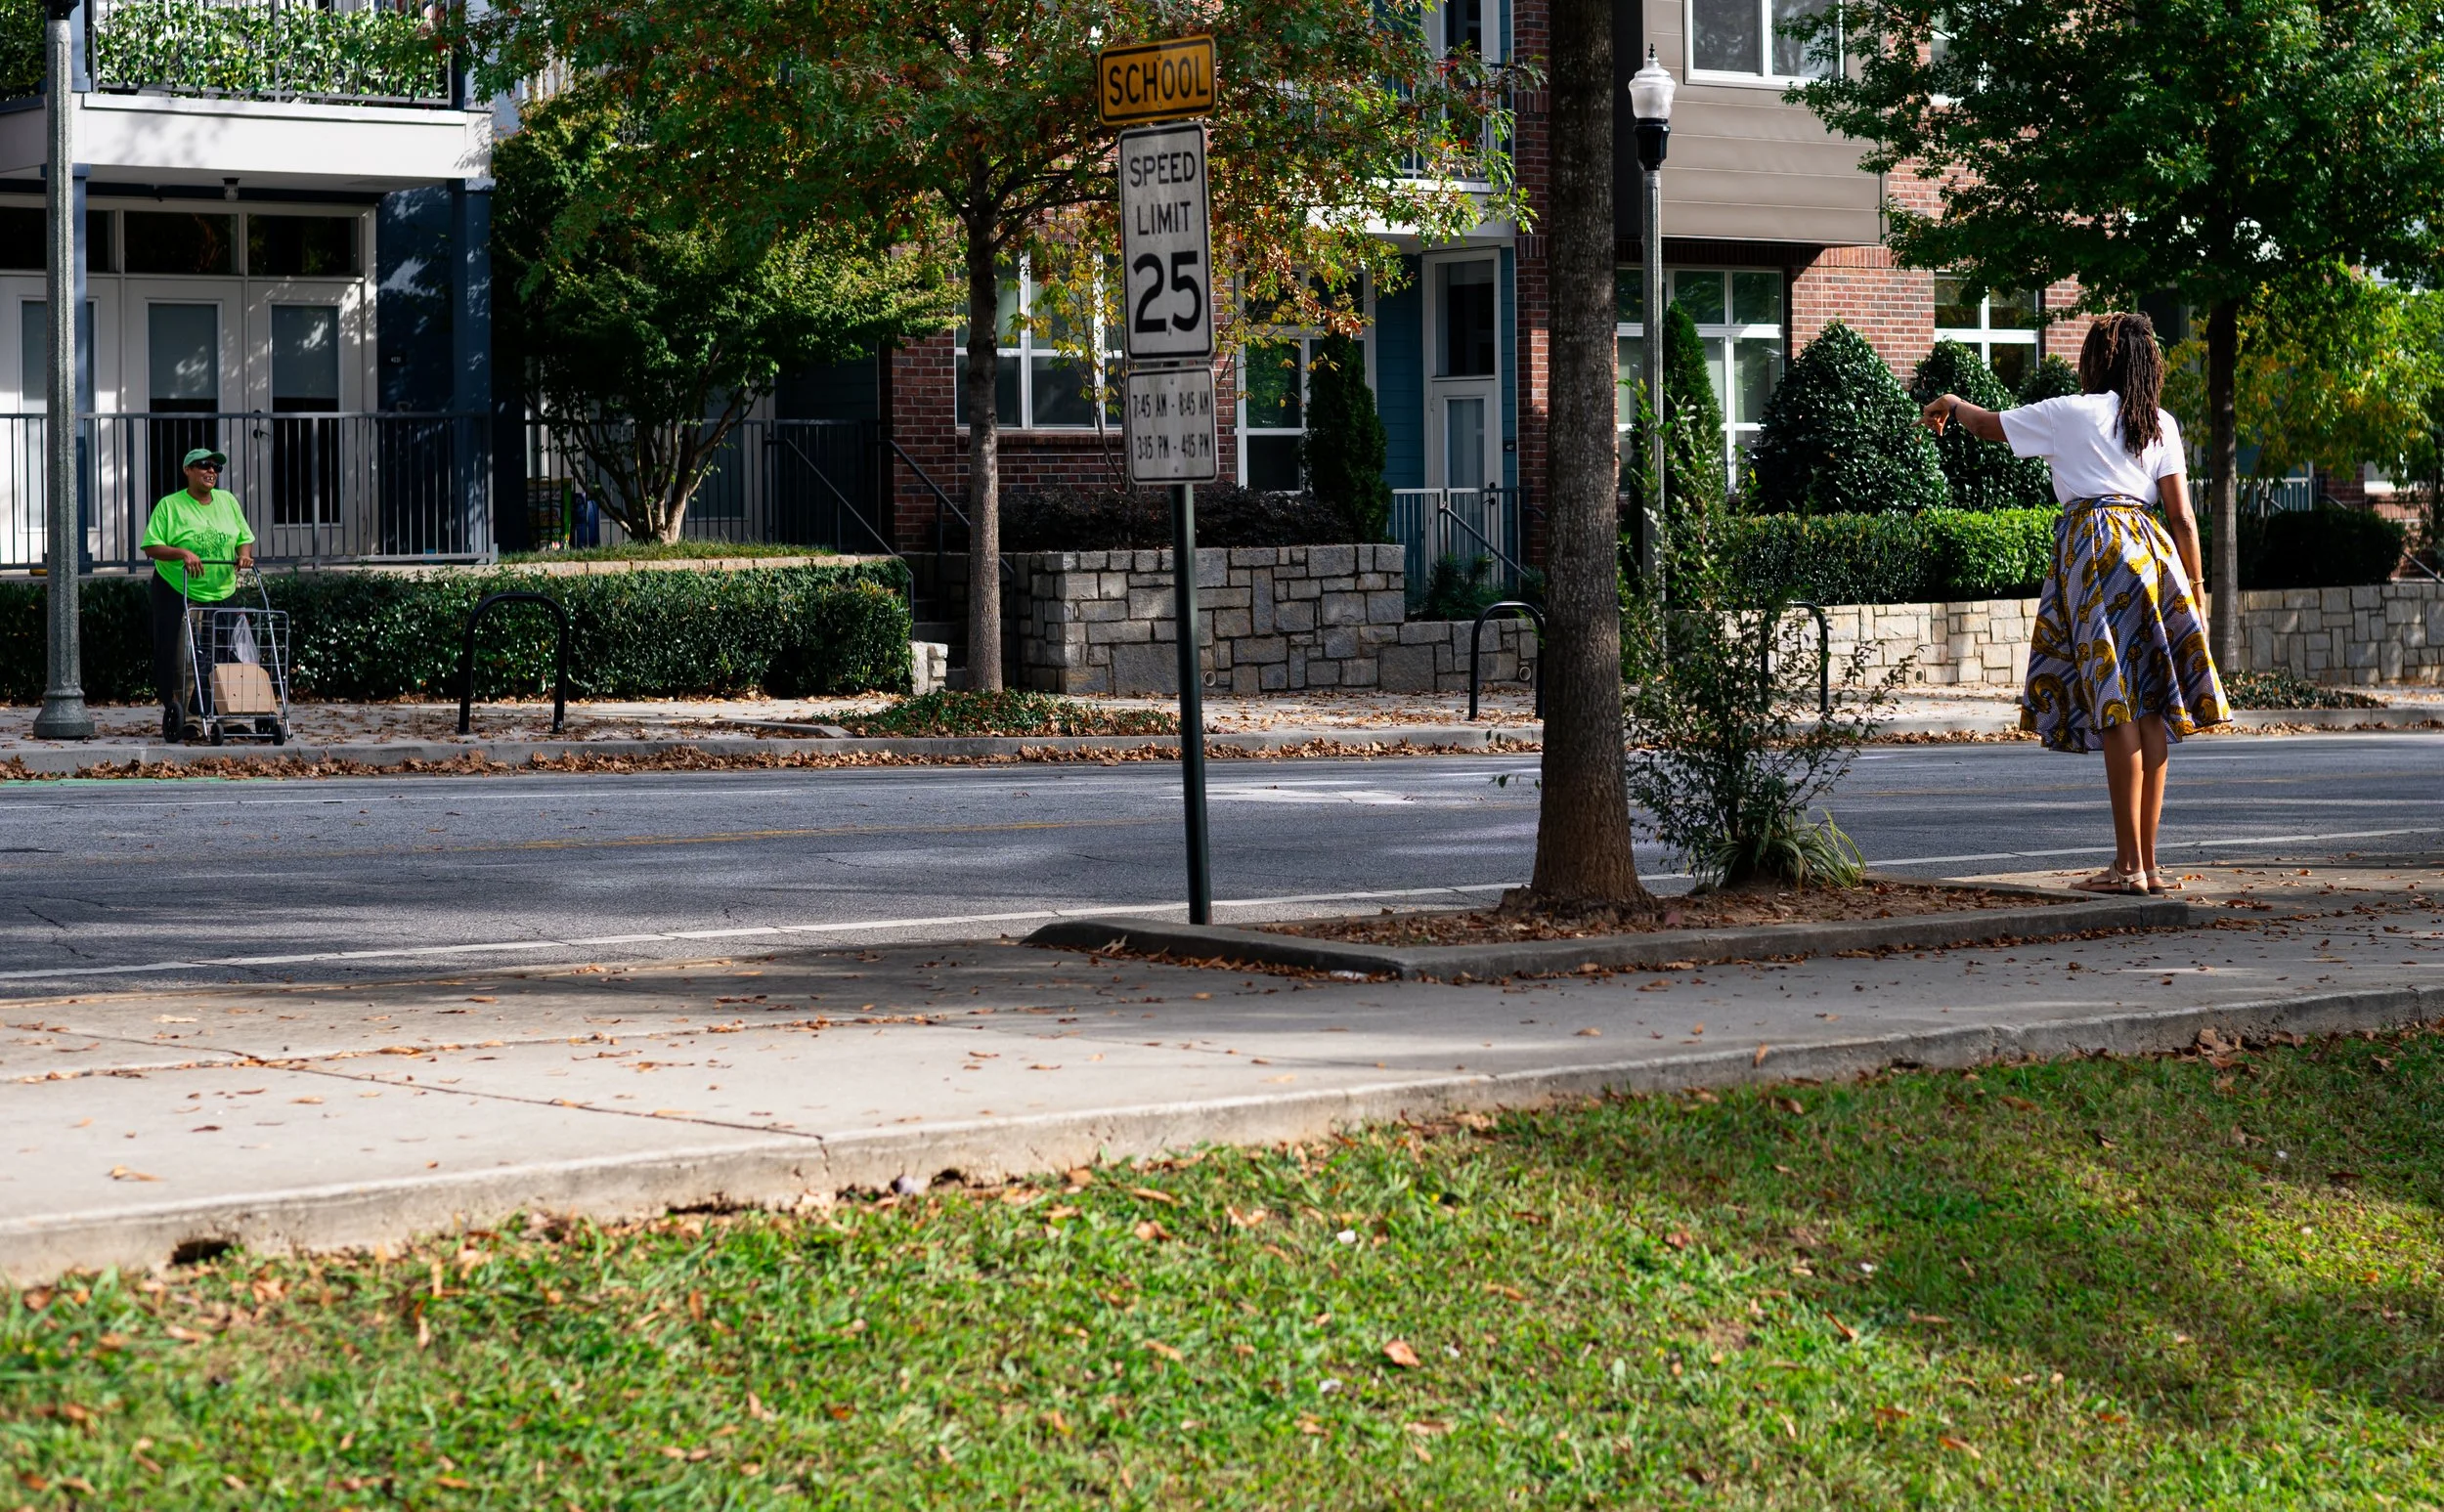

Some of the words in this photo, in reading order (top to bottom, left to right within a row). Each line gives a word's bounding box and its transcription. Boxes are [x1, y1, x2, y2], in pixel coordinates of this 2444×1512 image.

[1109, 56, 1208, 107] SCHOOL
[1130, 151, 1197, 188] SPEED
[1137, 201, 1192, 236] LIMIT
[1133, 250, 1201, 333] 25
[1133, 394, 1151, 418] 7:45
[1156, 393, 1167, 417] AM
[1179, 391, 1196, 416] 8:45
[1200, 391, 1209, 414] AM
[1137, 435, 1153, 459] 3:15
[1158, 434, 1169, 458] PM
[1181, 433, 1196, 458] 4:15
[1199, 433, 1210, 457] PM
